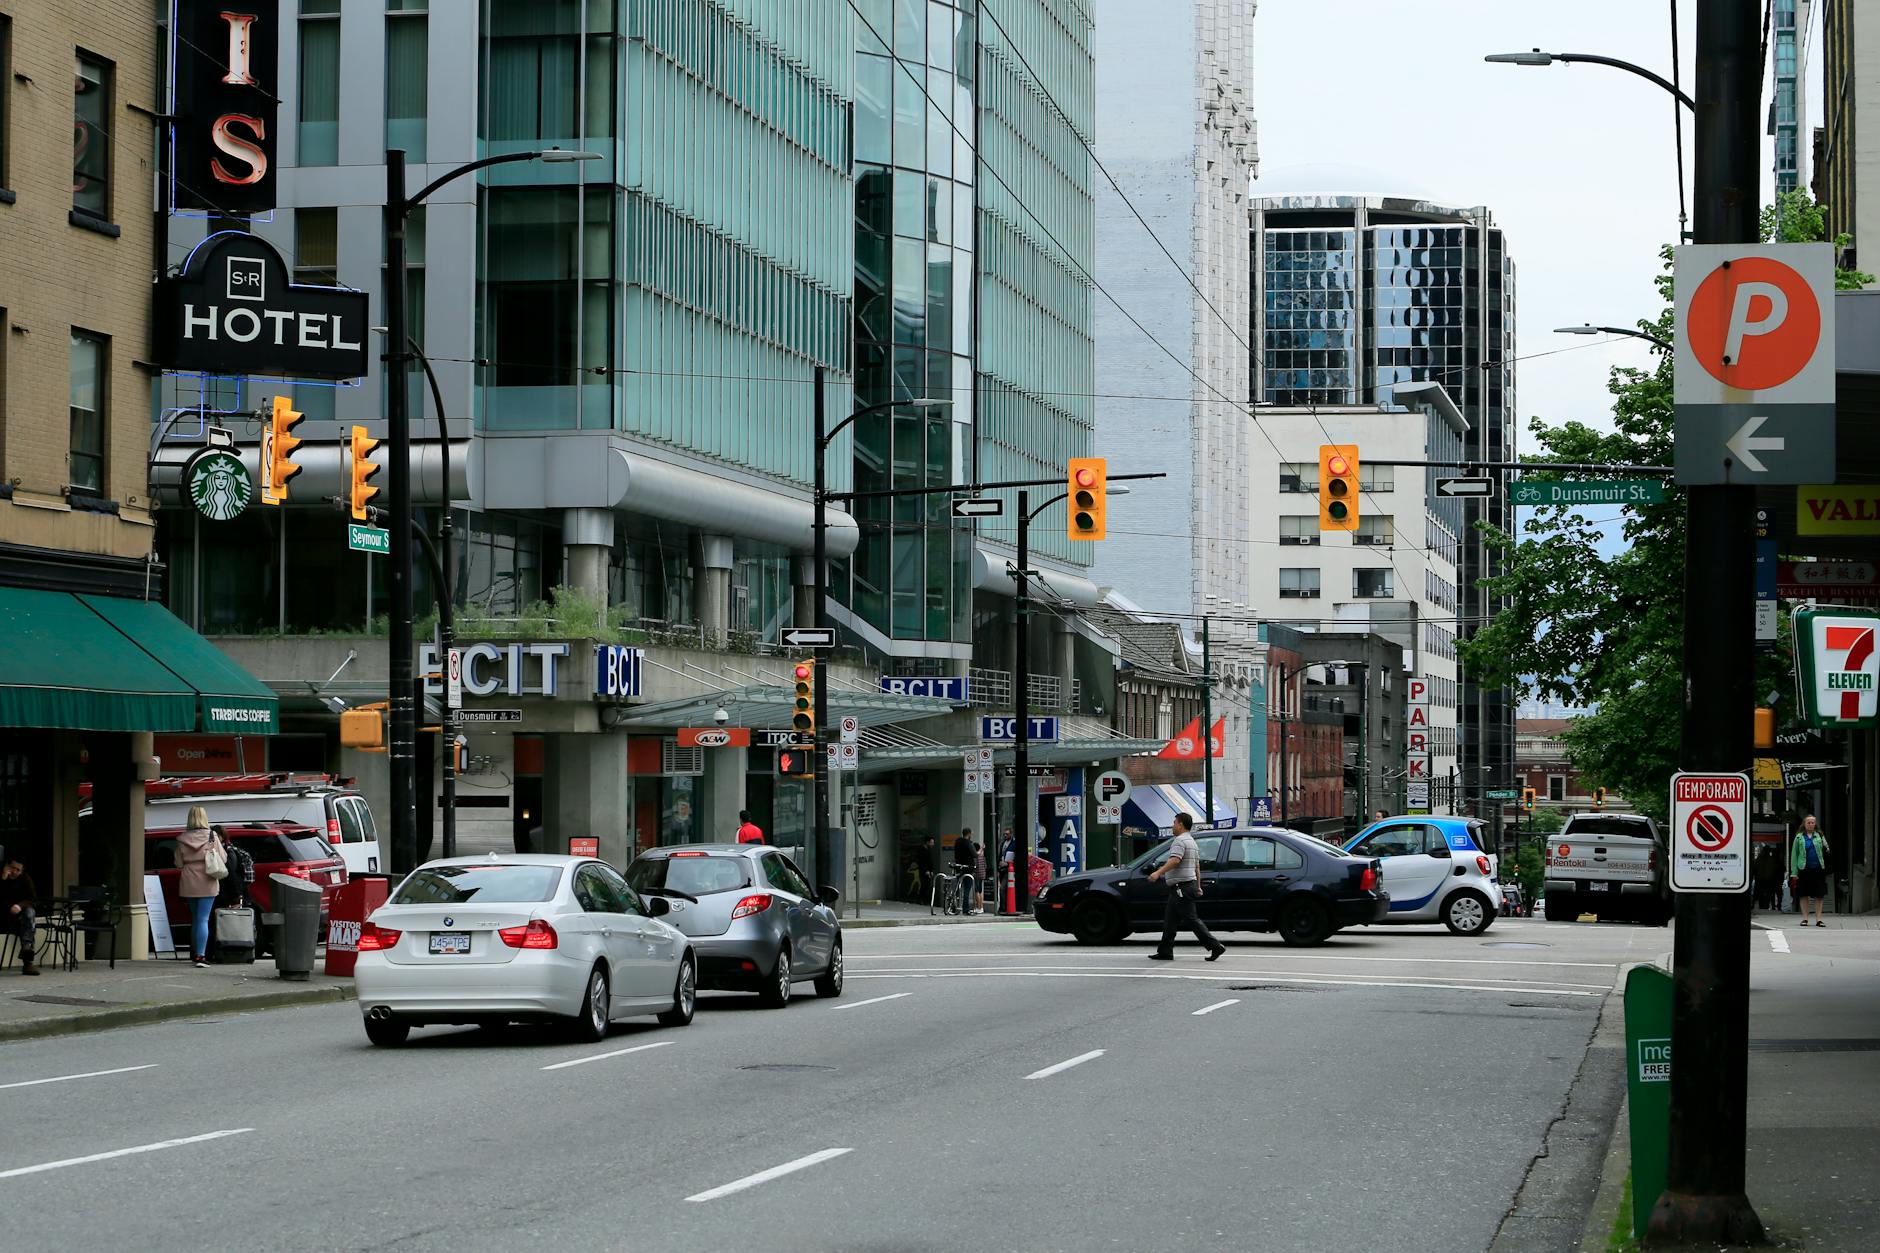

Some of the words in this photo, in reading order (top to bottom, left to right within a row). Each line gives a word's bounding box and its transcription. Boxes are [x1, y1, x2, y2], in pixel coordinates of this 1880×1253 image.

[183, 303, 361, 351] HOTEL
[1551, 485, 1626, 501] Dunsmuir
[1629, 484, 1651, 500] St.
[352, 527, 382, 547] Seymour
[607, 646, 645, 697] BCIT
[460, 712, 497, 721] Dunsmuir
[989, 718, 1047, 739] BCT
[1410, 681, 1426, 778] PARK
[701, 735, 726, 743] A&W
[1776, 732, 1808, 744] Every
[177, 748, 206, 760] Open
[1780, 760, 1792, 772] is
[1784, 772, 1808, 785] free
[1679, 782, 1742, 799] TEMPORARY
[1059, 819, 1078, 877] ARK
[1553, 859, 1587, 868] Rentokil
[330, 920, 361, 929] VISITOR
[329, 927, 361, 945] MAP
[1643, 1064, 1671, 1074] FREE
